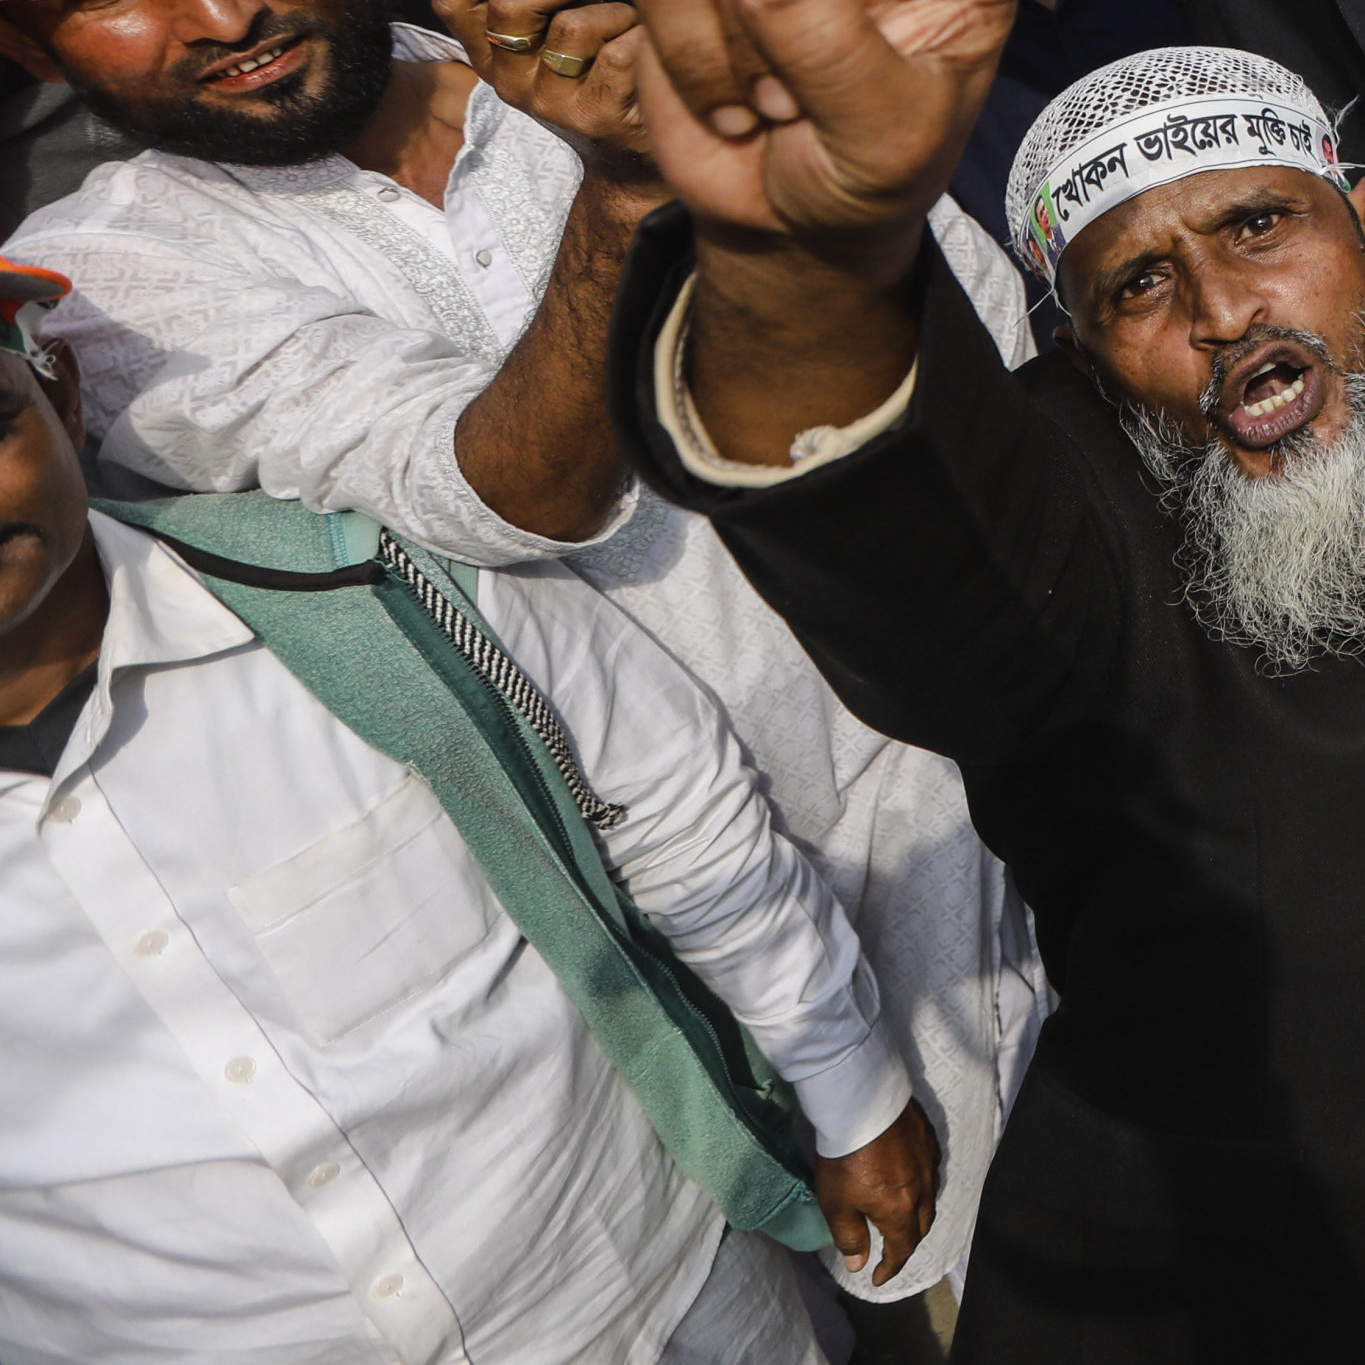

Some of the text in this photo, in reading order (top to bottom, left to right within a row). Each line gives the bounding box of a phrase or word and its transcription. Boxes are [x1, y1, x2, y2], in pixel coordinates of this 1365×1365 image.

[1051, 108, 1313, 221] খোকন ভাইয়ের মুক্তি চাই
